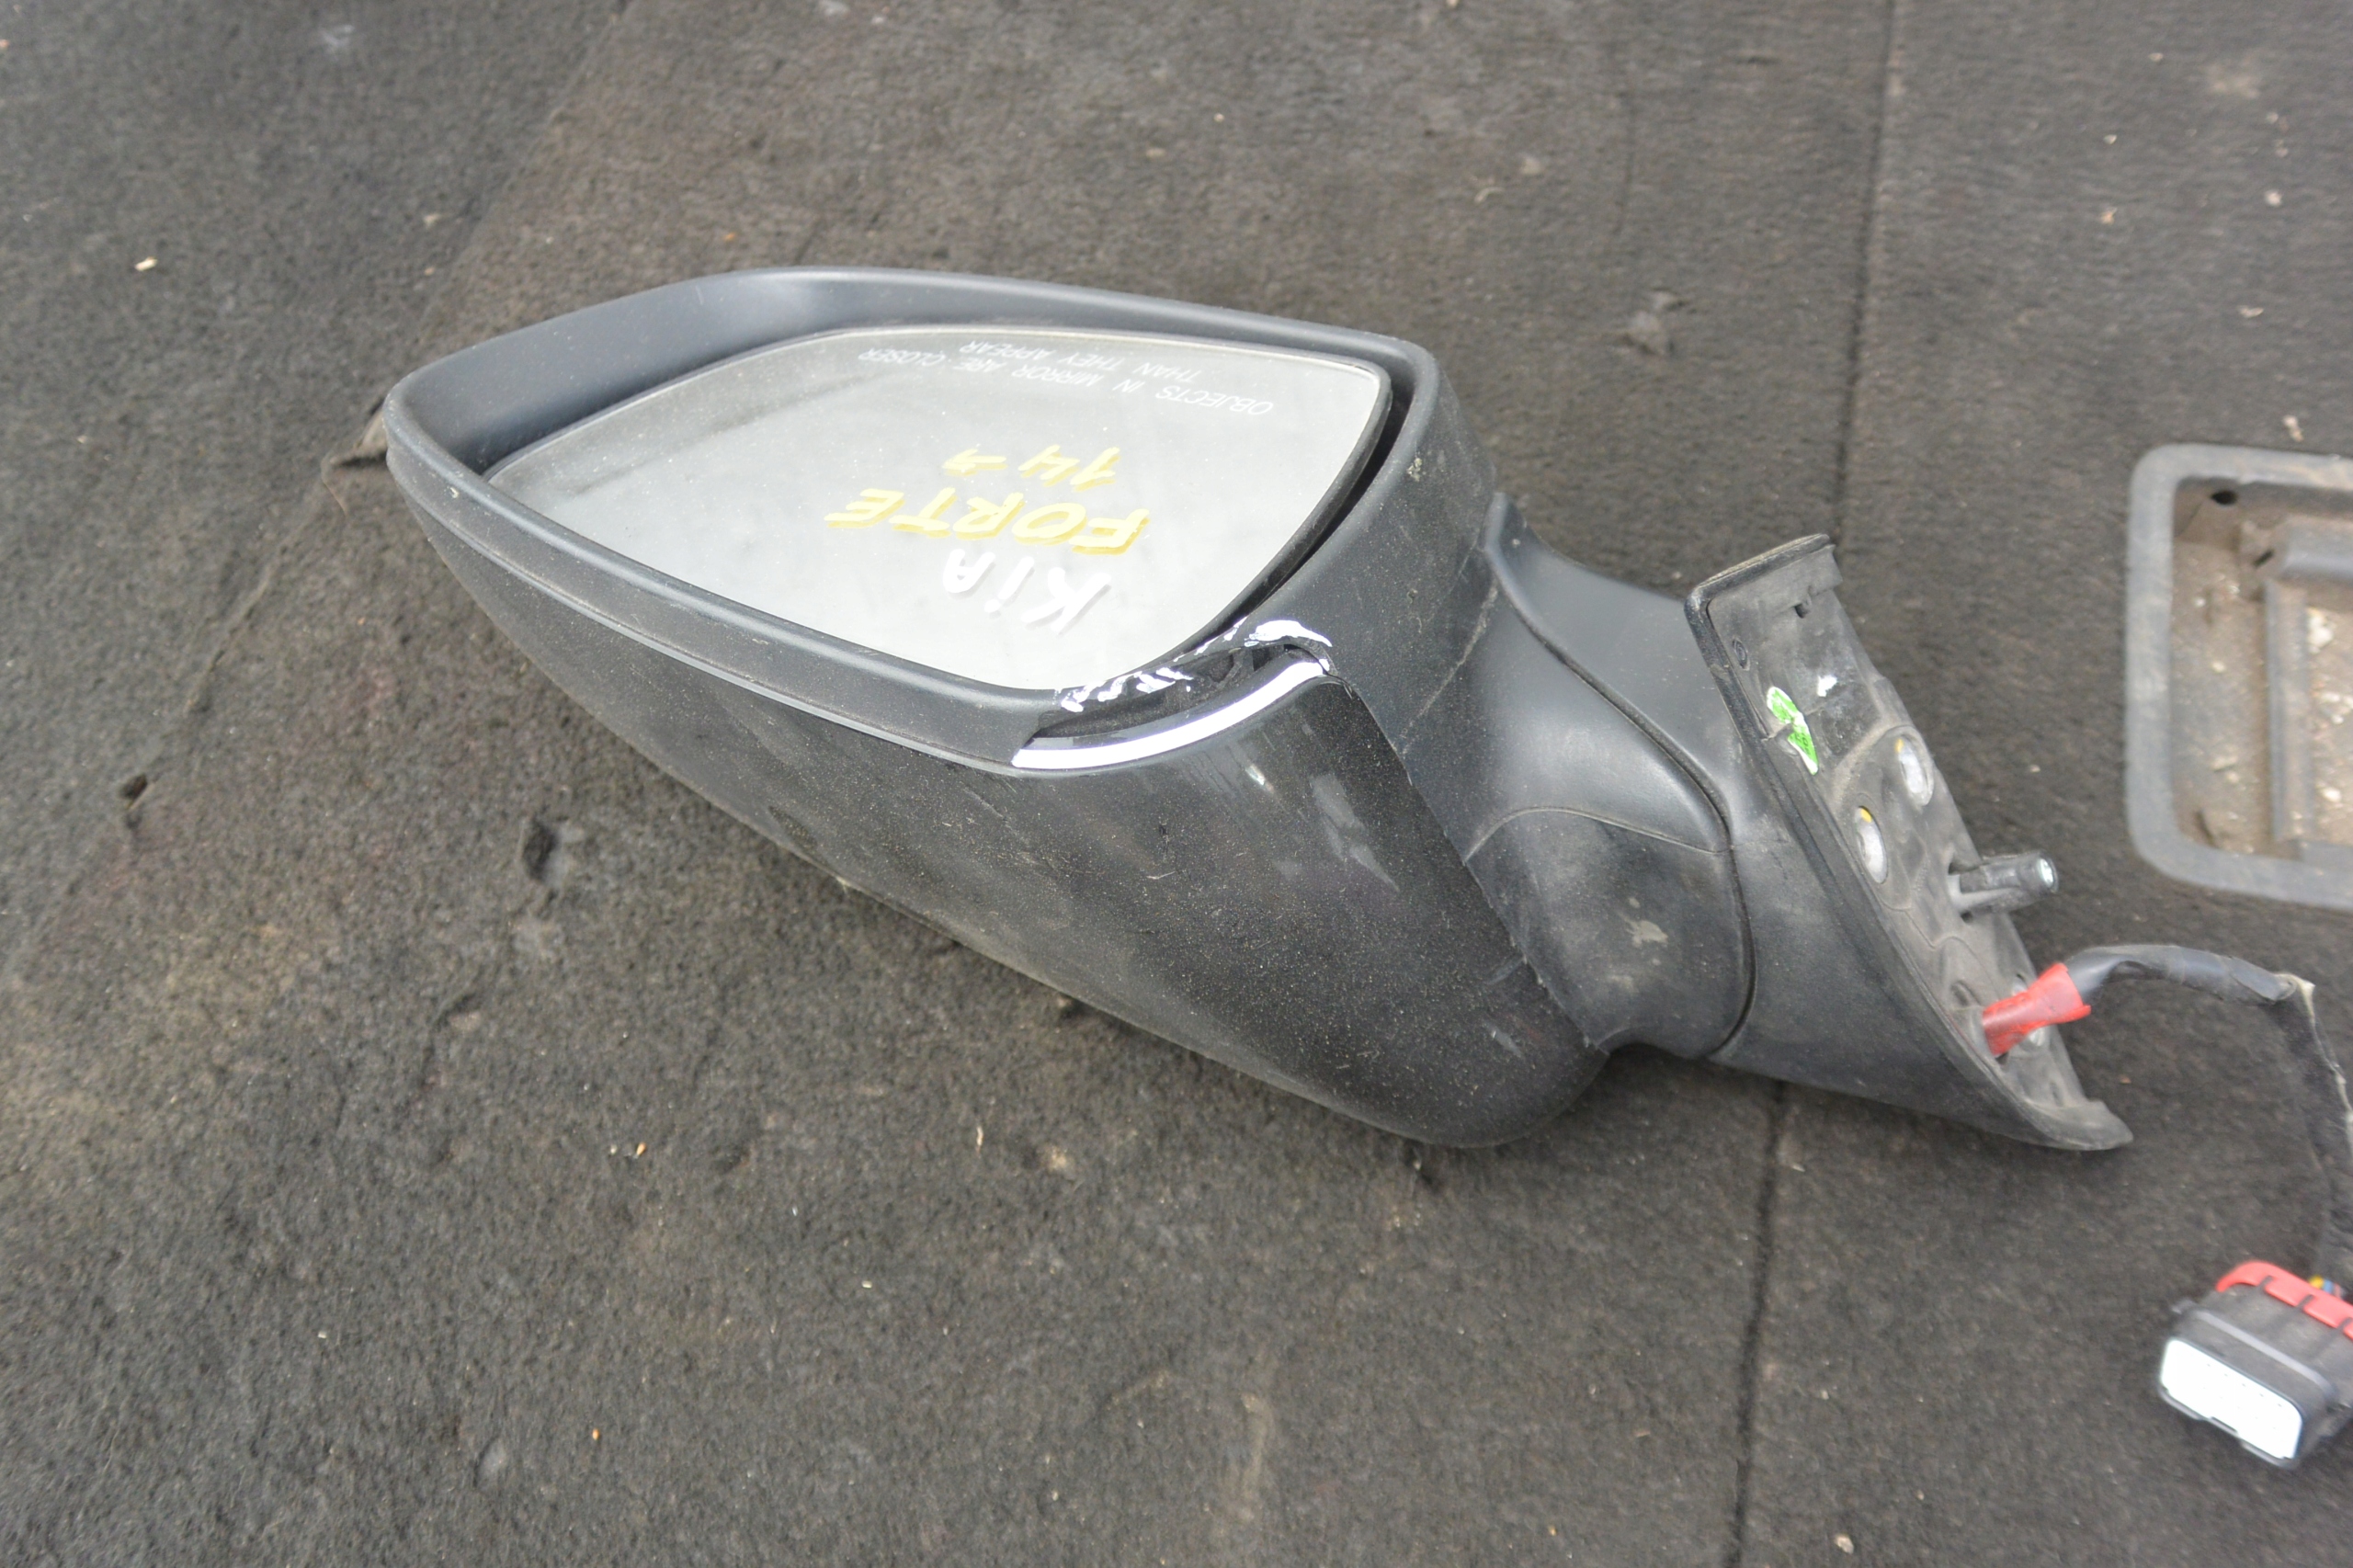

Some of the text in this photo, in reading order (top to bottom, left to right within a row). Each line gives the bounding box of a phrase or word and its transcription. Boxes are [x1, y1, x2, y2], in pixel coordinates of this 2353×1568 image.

[858, 347, 1274, 415] OBJECTS IN MIRROR ARE CLOSER
[959, 340, 1201, 382] THAN THEY APPEAR
[1018, 444, 1120, 489] 14
[824, 487, 1150, 553] FORTE
